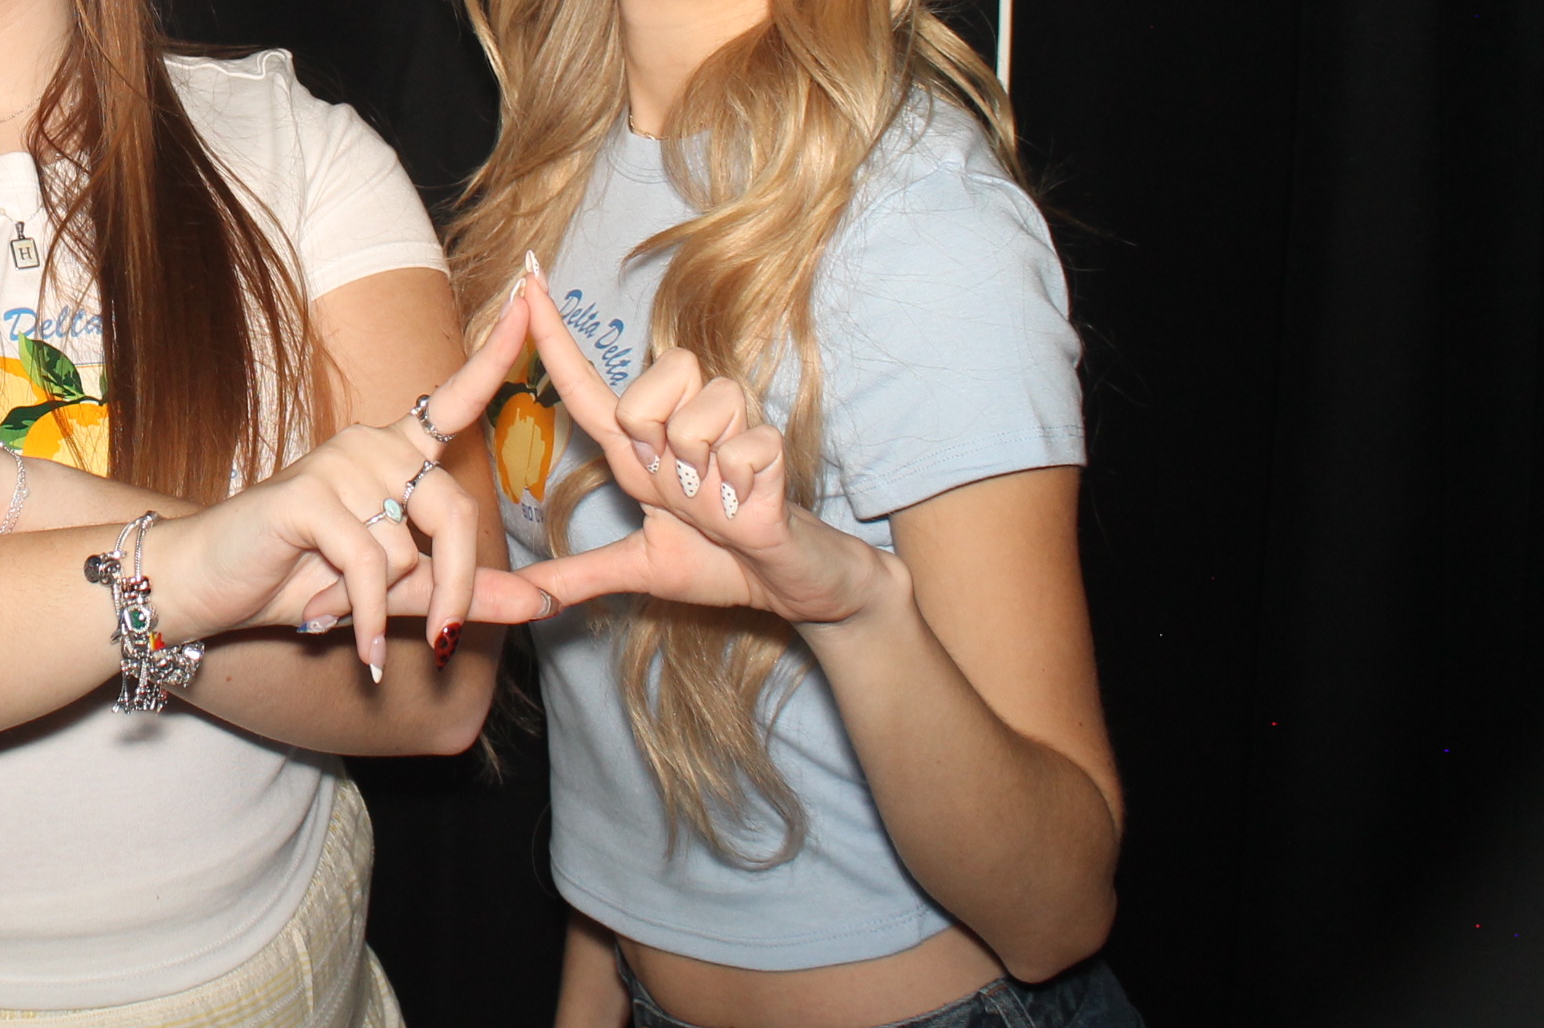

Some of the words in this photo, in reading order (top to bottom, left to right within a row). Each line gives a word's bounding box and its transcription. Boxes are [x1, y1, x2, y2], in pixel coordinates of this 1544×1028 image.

[18, 246, 33, 261] H
[4, 305, 104, 341] Delta
[559, 288, 601, 340] Delta
[594, 318, 633, 387] Delta
